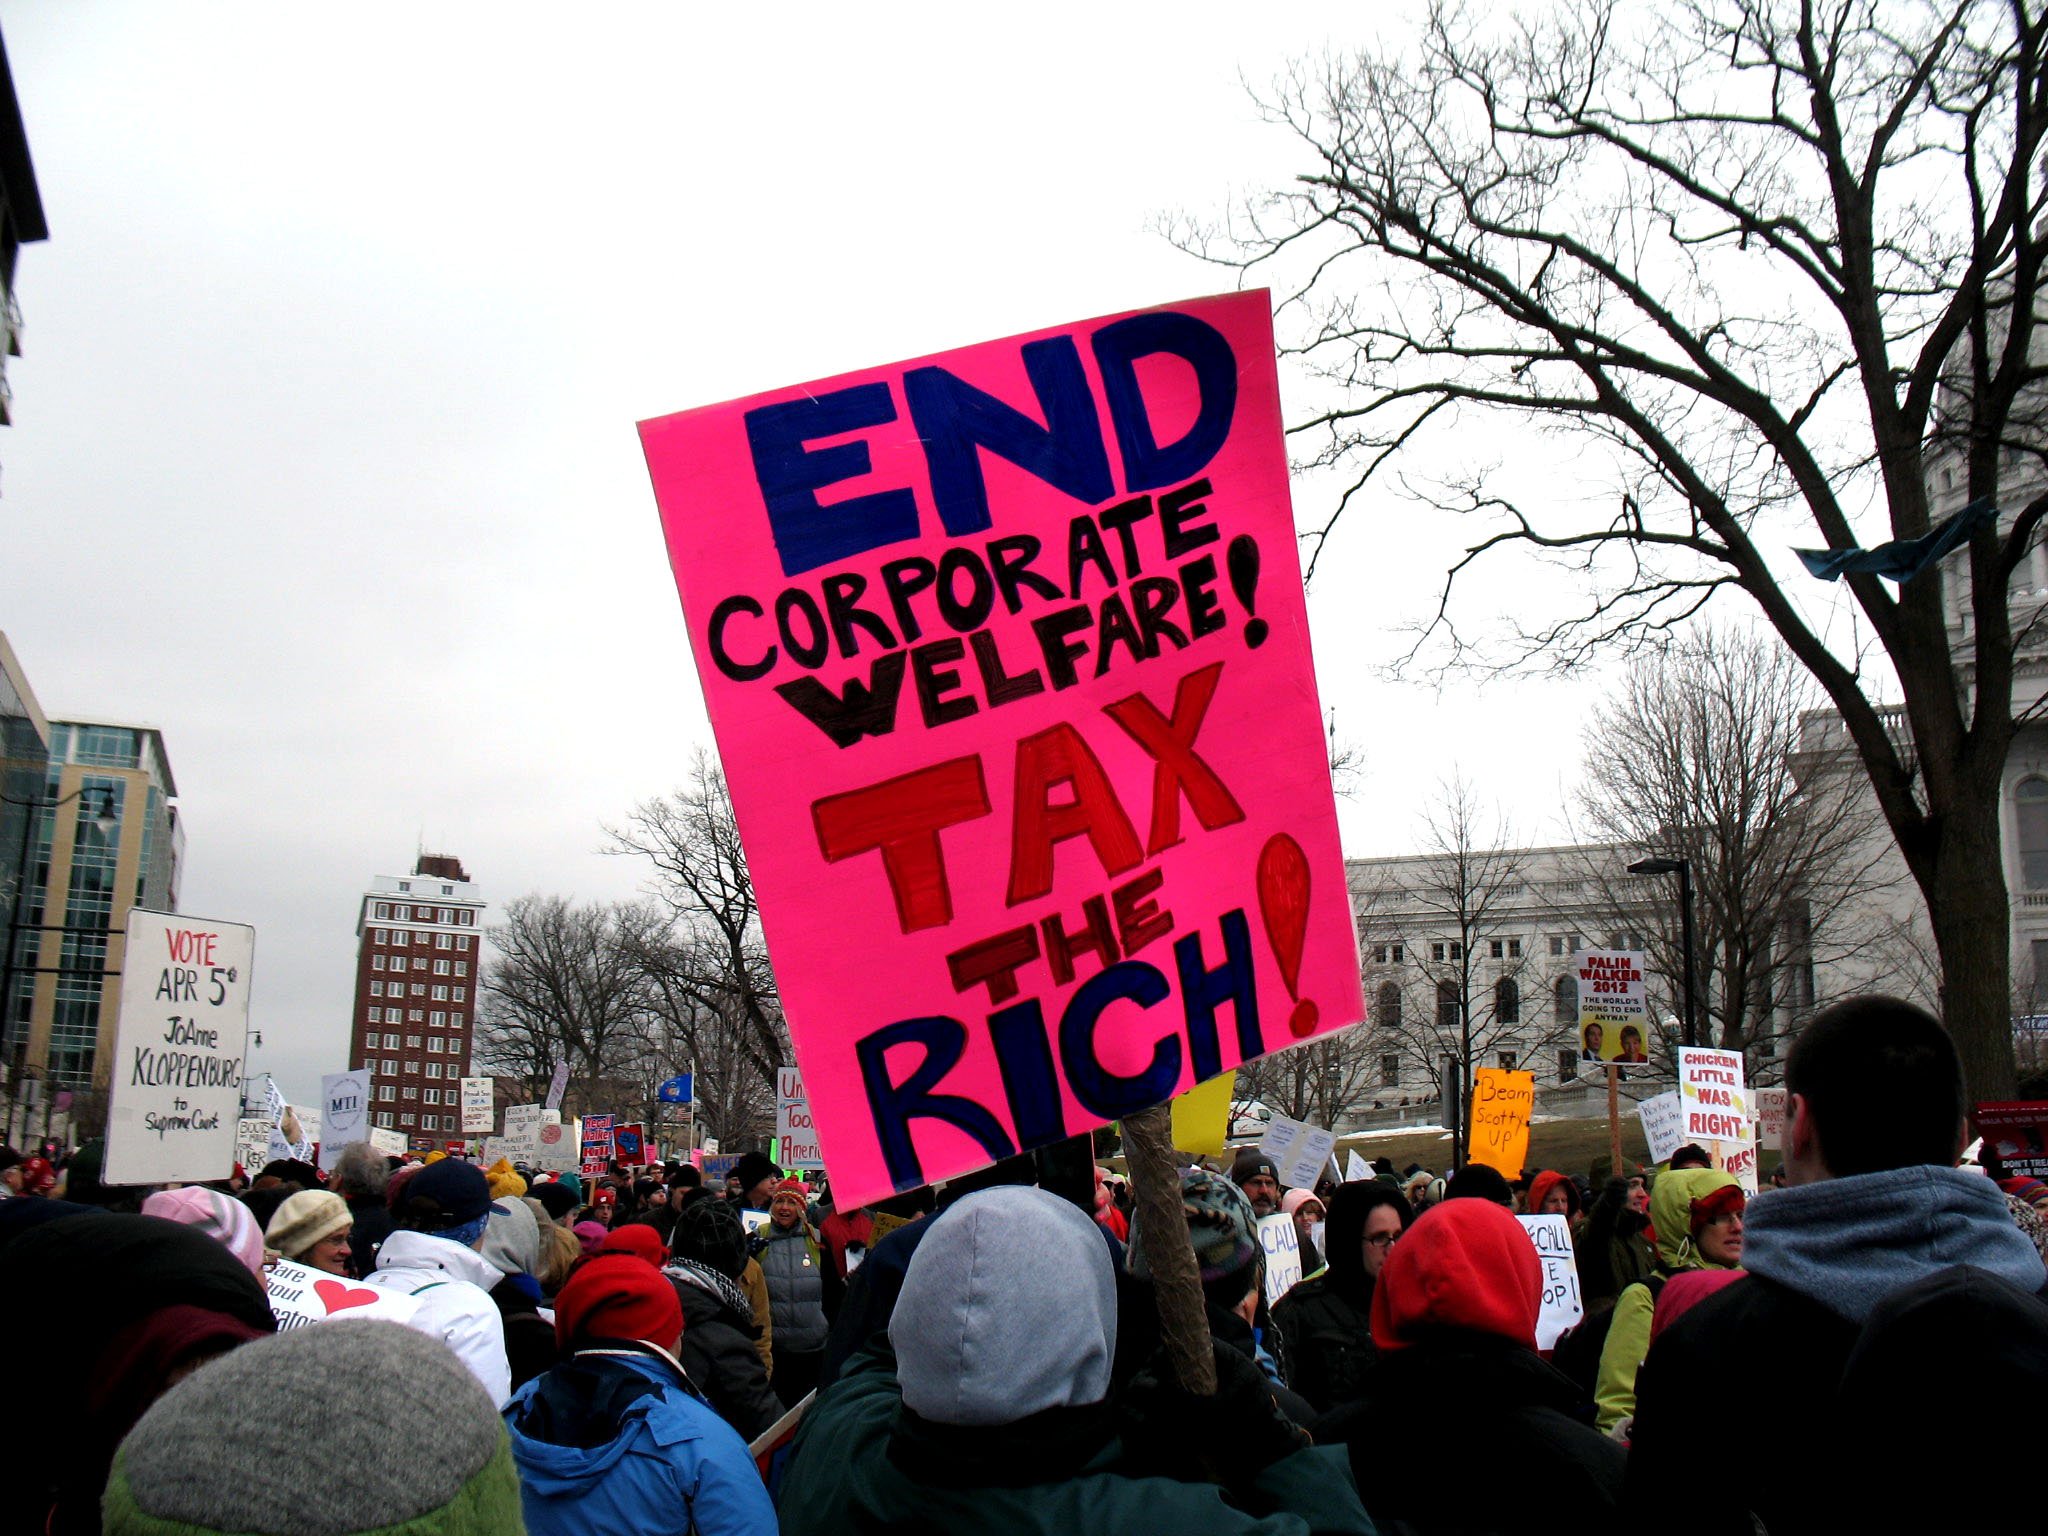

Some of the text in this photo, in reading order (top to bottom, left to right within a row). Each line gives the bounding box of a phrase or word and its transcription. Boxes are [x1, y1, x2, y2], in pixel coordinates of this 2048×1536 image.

[743, 311, 1238, 577] END
[708, 477, 1221, 682] CORPORATE
[773, 533, 1269, 749] WELFARE!
[810, 661, 1246, 934] TAX
[945, 866, 1175, 1006] THE
[165, 927, 219, 967] VOTE
[1588, 956, 1632, 970] PALIN
[1579, 969, 1642, 983] WALKER
[155, 967, 199, 1003] APR
[1593, 981, 1629, 994] 2012
[1585, 996, 1639, 1005] THE WORLD'S
[855, 832, 1319, 1193] RICH!
[1582, 1004, 1609, 1013] GOING
[1624, 1006, 1642, 1014] END
[1595, 1013, 1629, 1022] ANYWAY
[131, 1046, 240, 1089] KLOPPENBURG
[1684, 1053, 1738, 1069] CHICKEN
[1689, 1069, 1736, 1086] LITTLE
[782, 1073, 806, 1099] Un
[1481, 1076, 1530, 1103] Beam
[174, 1096, 188, 1110] to
[332, 1096, 358, 1112] MTI
[1698, 1088, 1731, 1107] WAS
[1763, 1093, 1785, 1104] FOX
[584, 1116, 612, 1128] Recall
[1475, 1107, 1524, 1136] Scotty
[1689, 1112, 1742, 1137] RIGHT
[582, 1129, 613, 1141] Walker
[583, 1145, 609, 1157] Kill
[582, 1162, 608, 1173] Bill
[2002, 1160, 2027, 1169] DON'T
[2012, 1168, 2031, 1177] OUR
[1261, 1222, 1298, 1254] CALL
